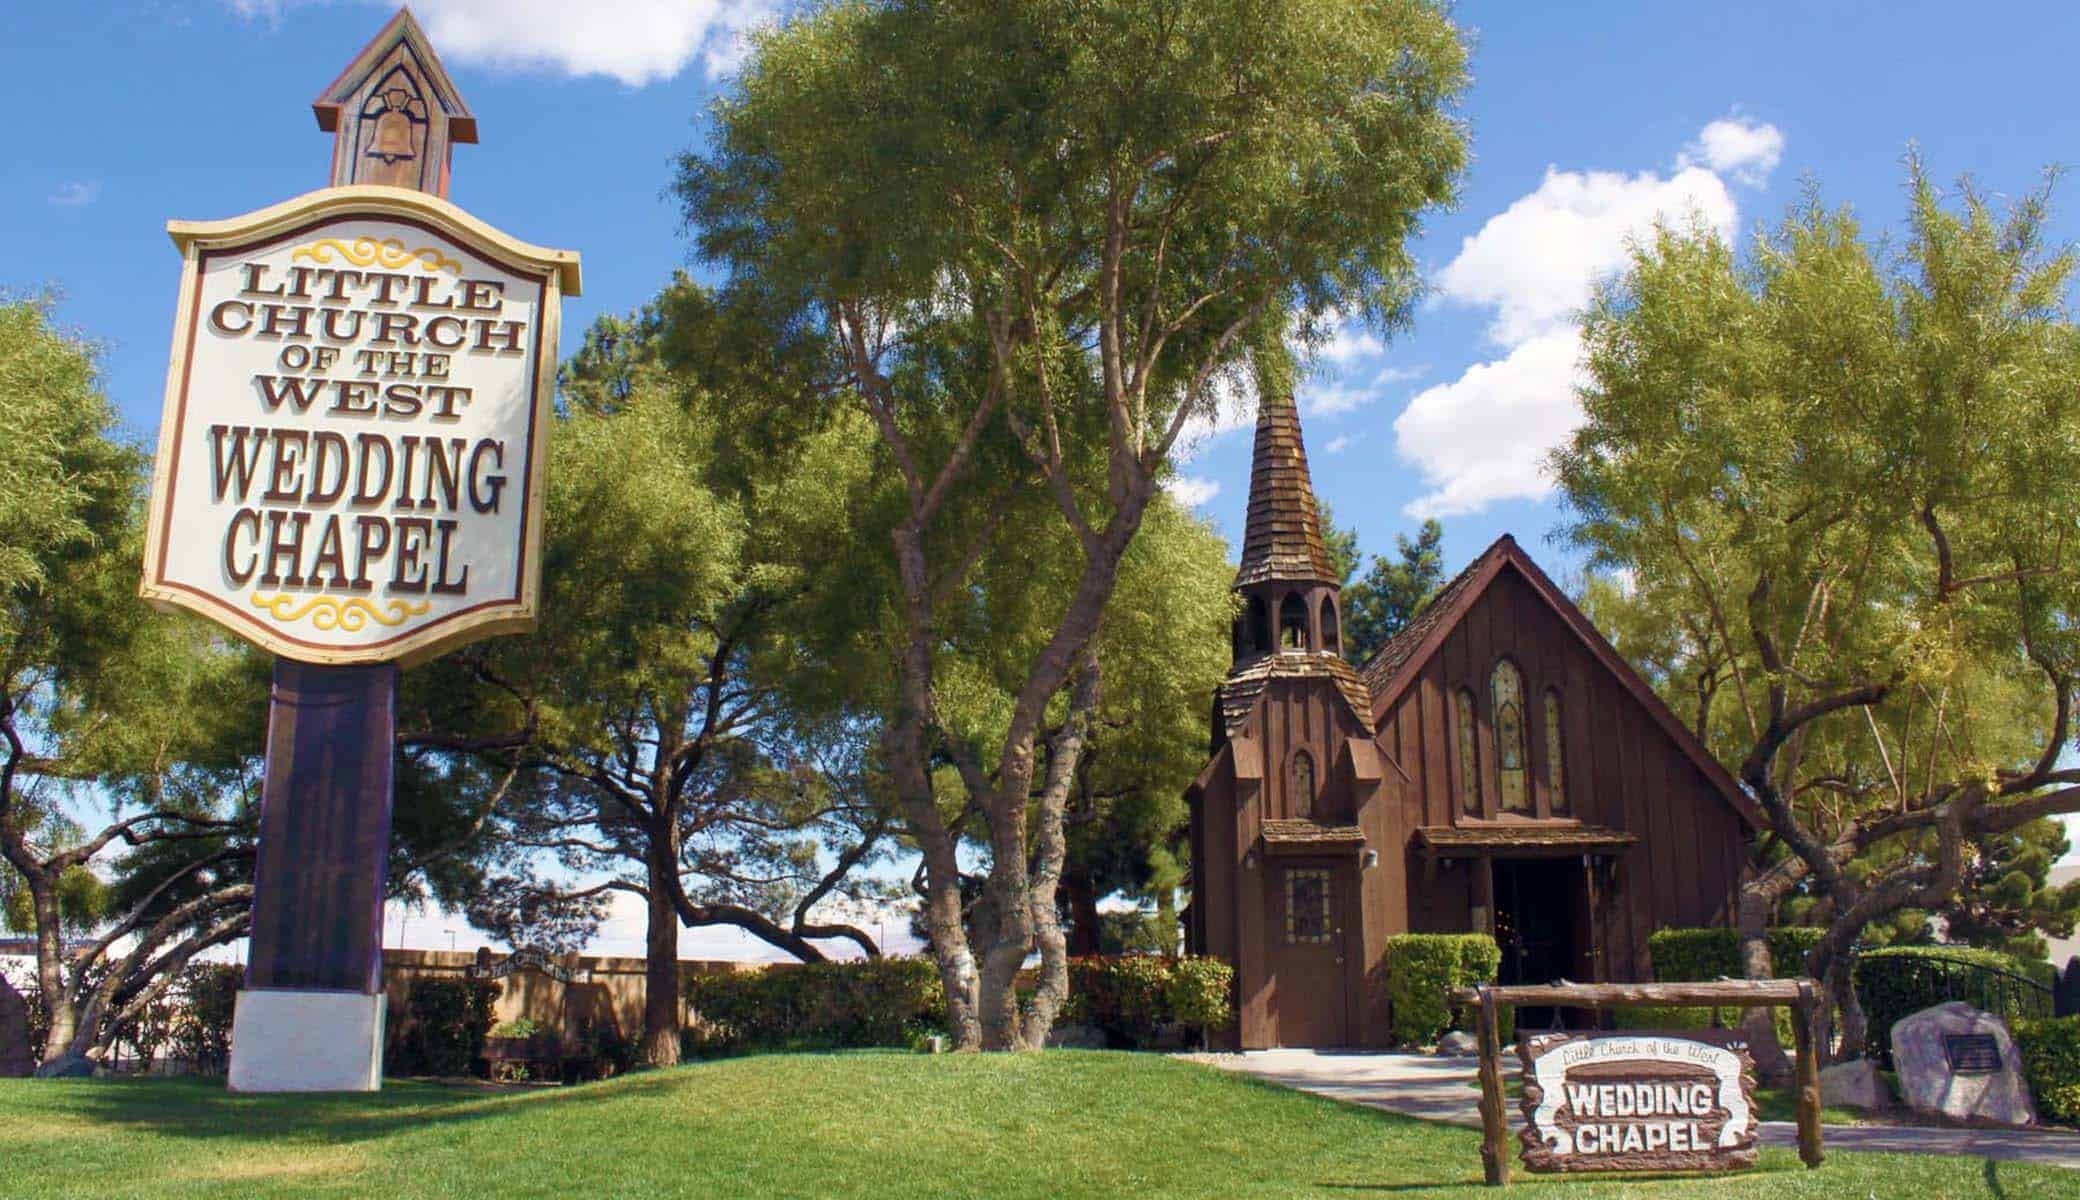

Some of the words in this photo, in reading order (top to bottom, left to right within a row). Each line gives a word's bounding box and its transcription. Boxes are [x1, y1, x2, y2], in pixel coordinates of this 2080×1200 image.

[241, 263, 505, 314] LITTLE
[211, 300, 527, 352] CHURCH
[281, 344, 340, 372] OF
[357, 349, 451, 378] THE
[254, 375, 473, 418] WEST
[209, 424, 506, 514] WEDDING
[224, 507, 468, 594] CHAPEL
[1563, 1043, 1594, 1065] Little
[1601, 1040, 1640, 1057] Church
[1646, 1041, 1657, 1056] of
[1663, 1041, 1680, 1056] the
[1567, 1083, 1713, 1116] WEDDING
[1575, 1123, 1713, 1153] CHAPEL
